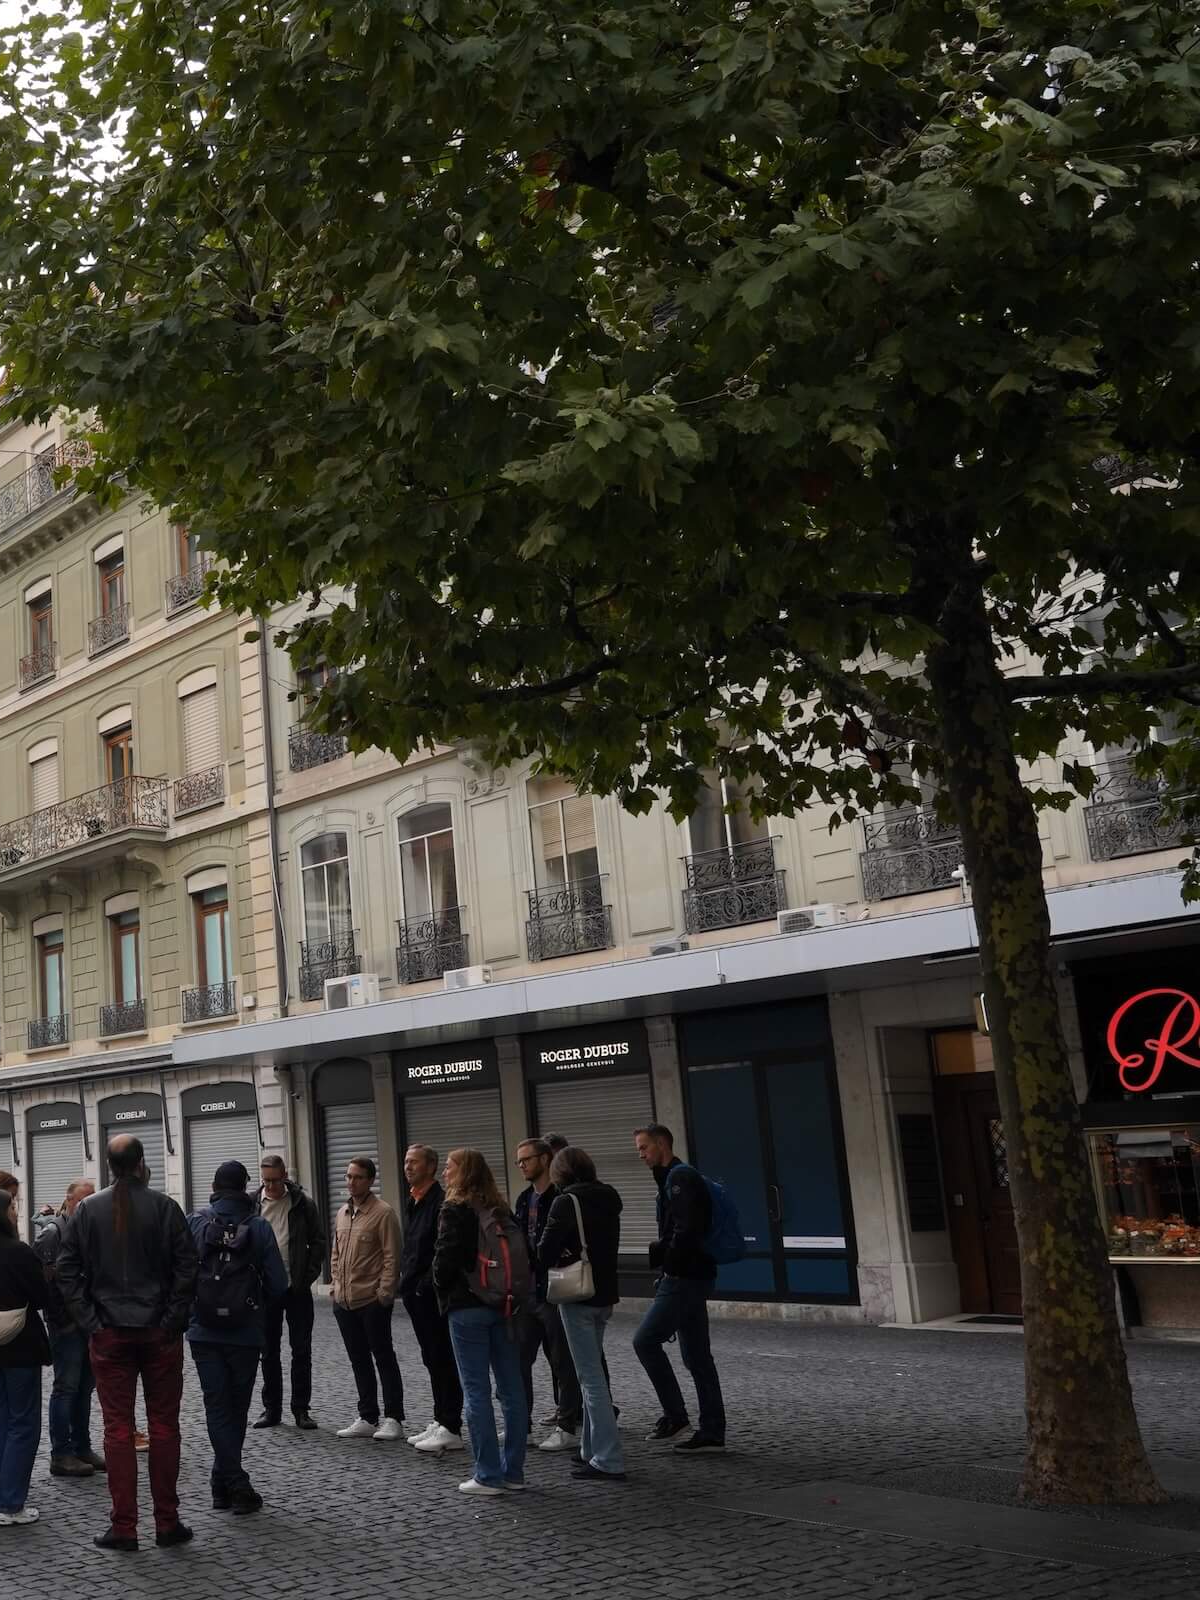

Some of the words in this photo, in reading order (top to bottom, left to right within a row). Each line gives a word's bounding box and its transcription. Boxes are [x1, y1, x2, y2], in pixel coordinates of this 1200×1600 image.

[1107, 988, 1200, 1092] R
[540, 1048, 581, 1064] ROGER
[583, 1042, 630, 1059] DUBUIS
[407, 1064, 443, 1078] ROGER
[444, 1059, 483, 1074] DUBUIS
[200, 1101, 236, 1112] GOBELIN
[115, 1110, 147, 1120] GOBELIN
[40, 1119, 68, 1128] GOBELIN
